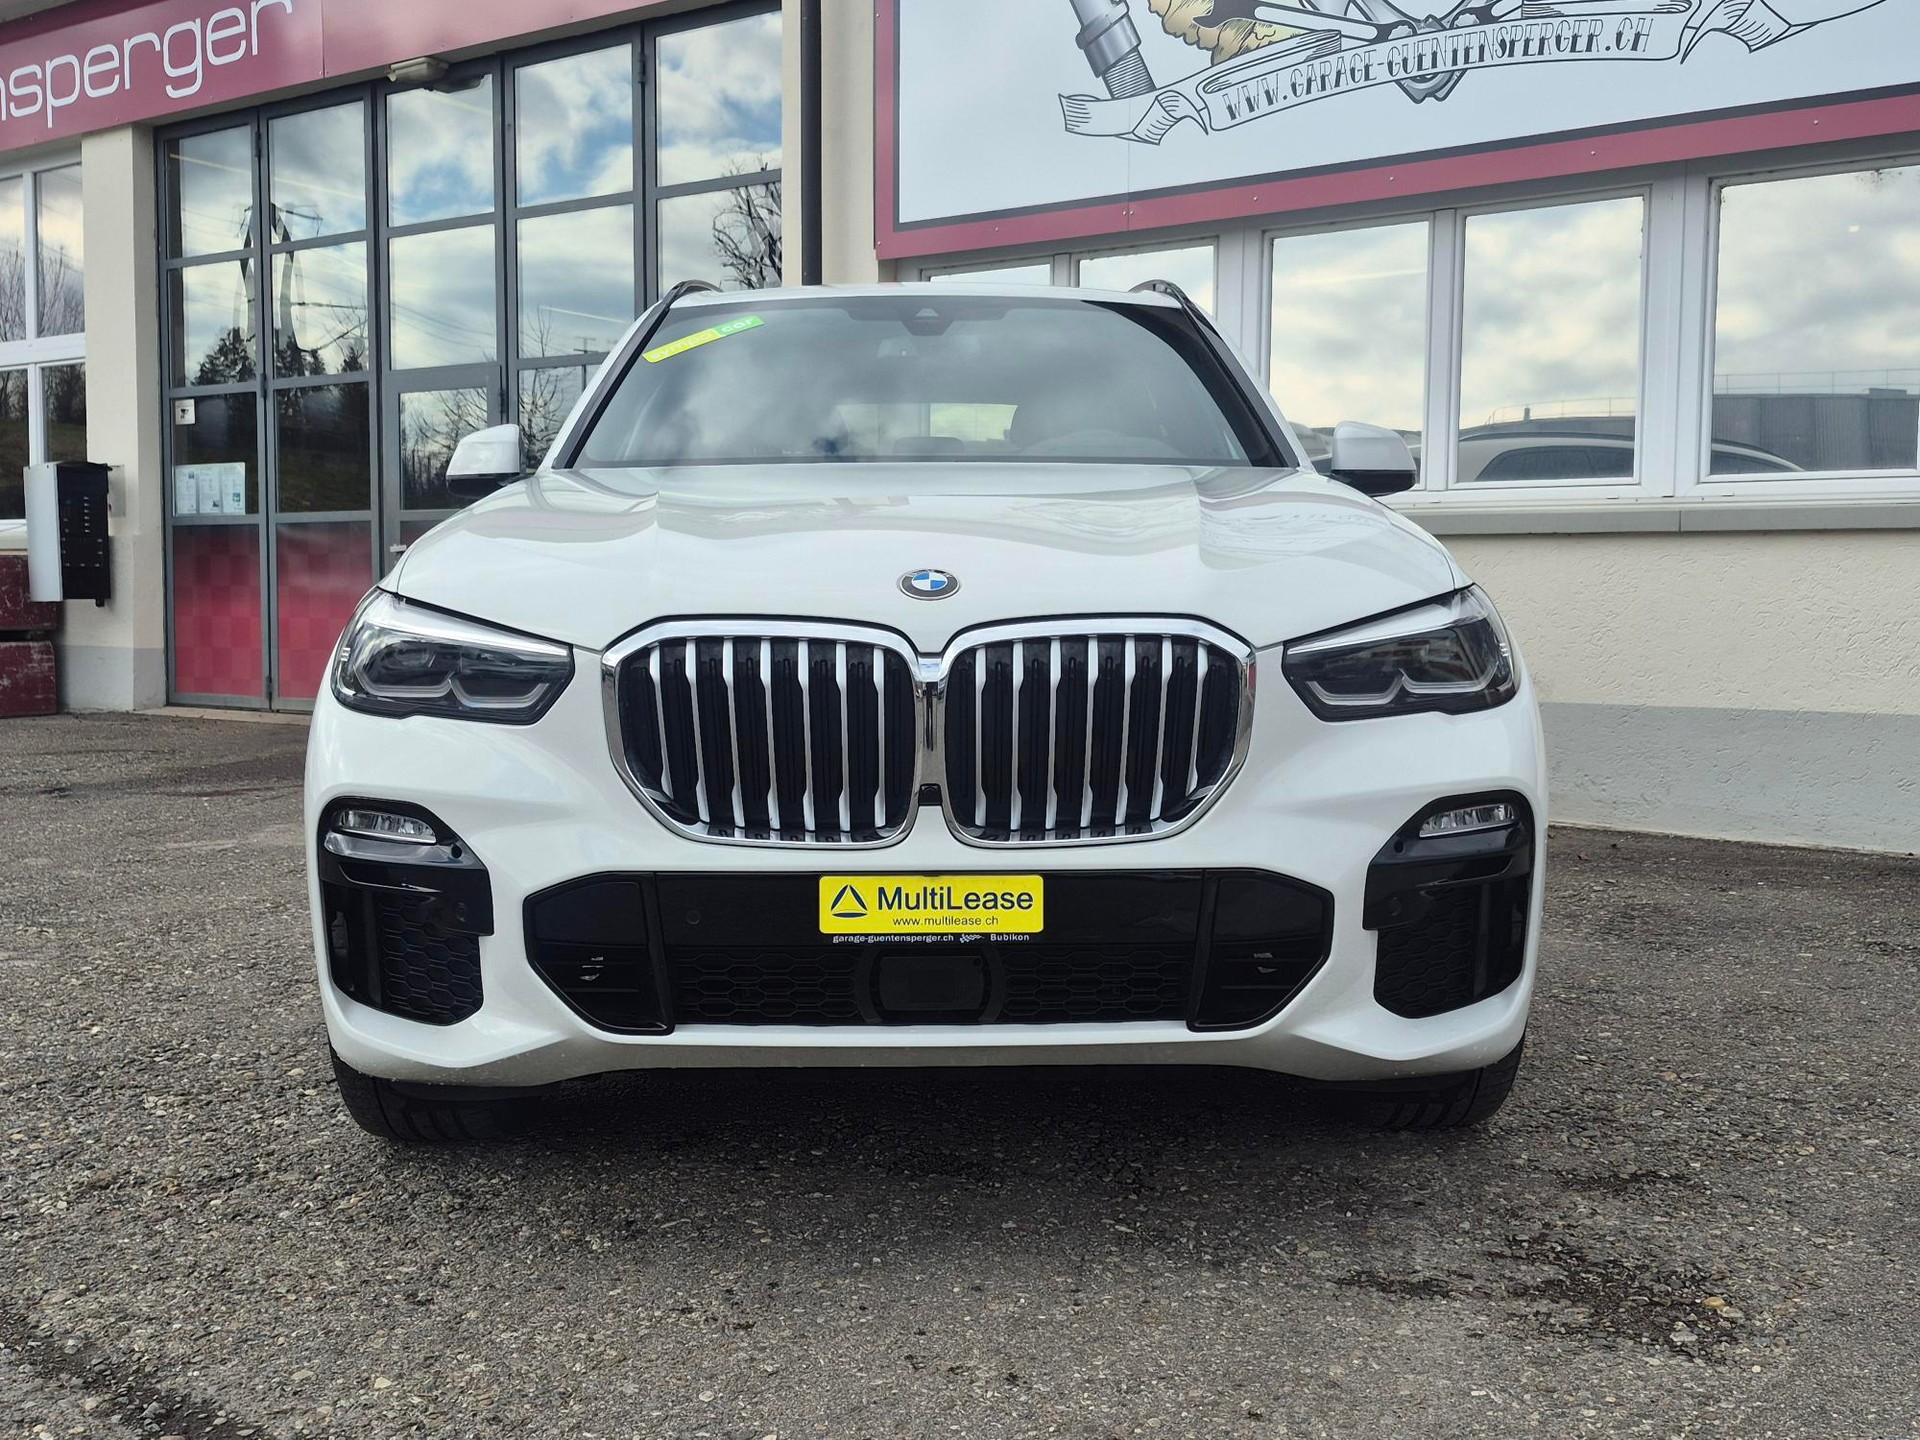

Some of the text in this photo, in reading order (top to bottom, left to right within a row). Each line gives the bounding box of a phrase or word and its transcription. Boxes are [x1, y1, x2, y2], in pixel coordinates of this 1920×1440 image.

[0, 0, 293, 128] sperger
[1222, 17, 1655, 121] WWW.GARAGE-GUENTENSPERGER.CH
[877, 886, 1034, 911] MultiLease
[892, 915, 999, 926] www.multilease.ch
[832, 933, 1030, 944] garage-guentensperger.ch Bubikon
